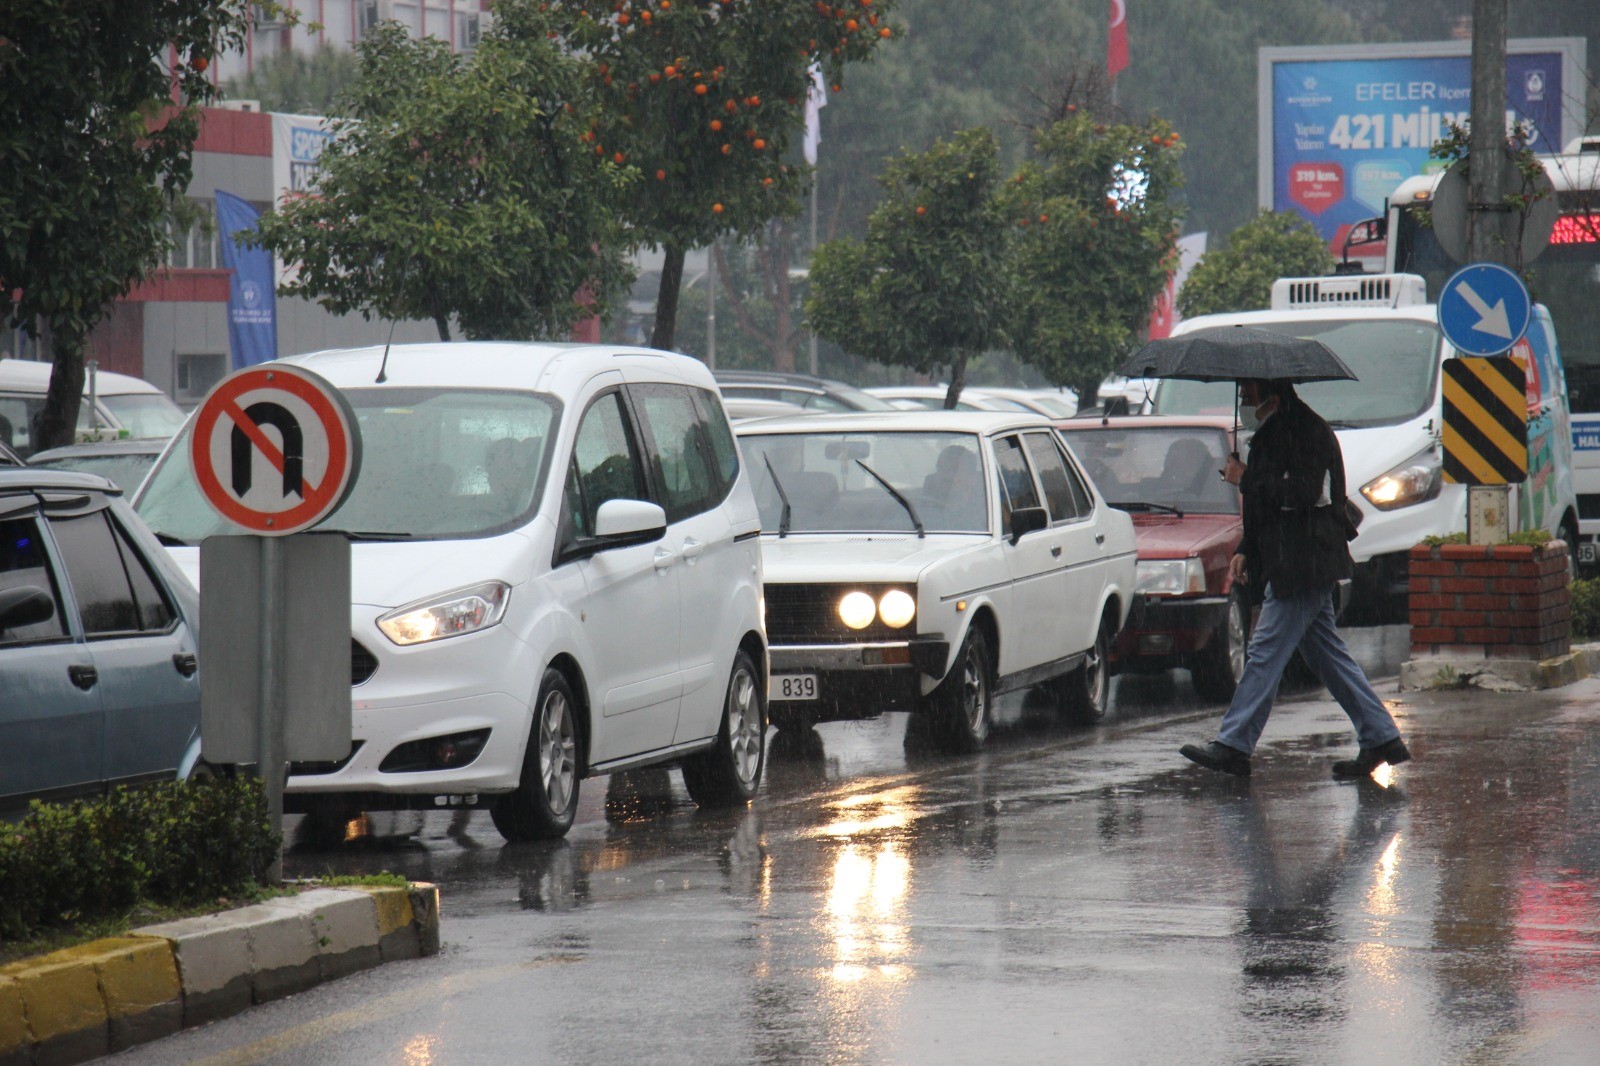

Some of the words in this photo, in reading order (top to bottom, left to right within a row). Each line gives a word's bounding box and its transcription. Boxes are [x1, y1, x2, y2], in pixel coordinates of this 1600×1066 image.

[1355, 81, 1436, 101] EFELER
[1329, 113, 1385, 149] 421
[782, 677, 815, 697] 839
